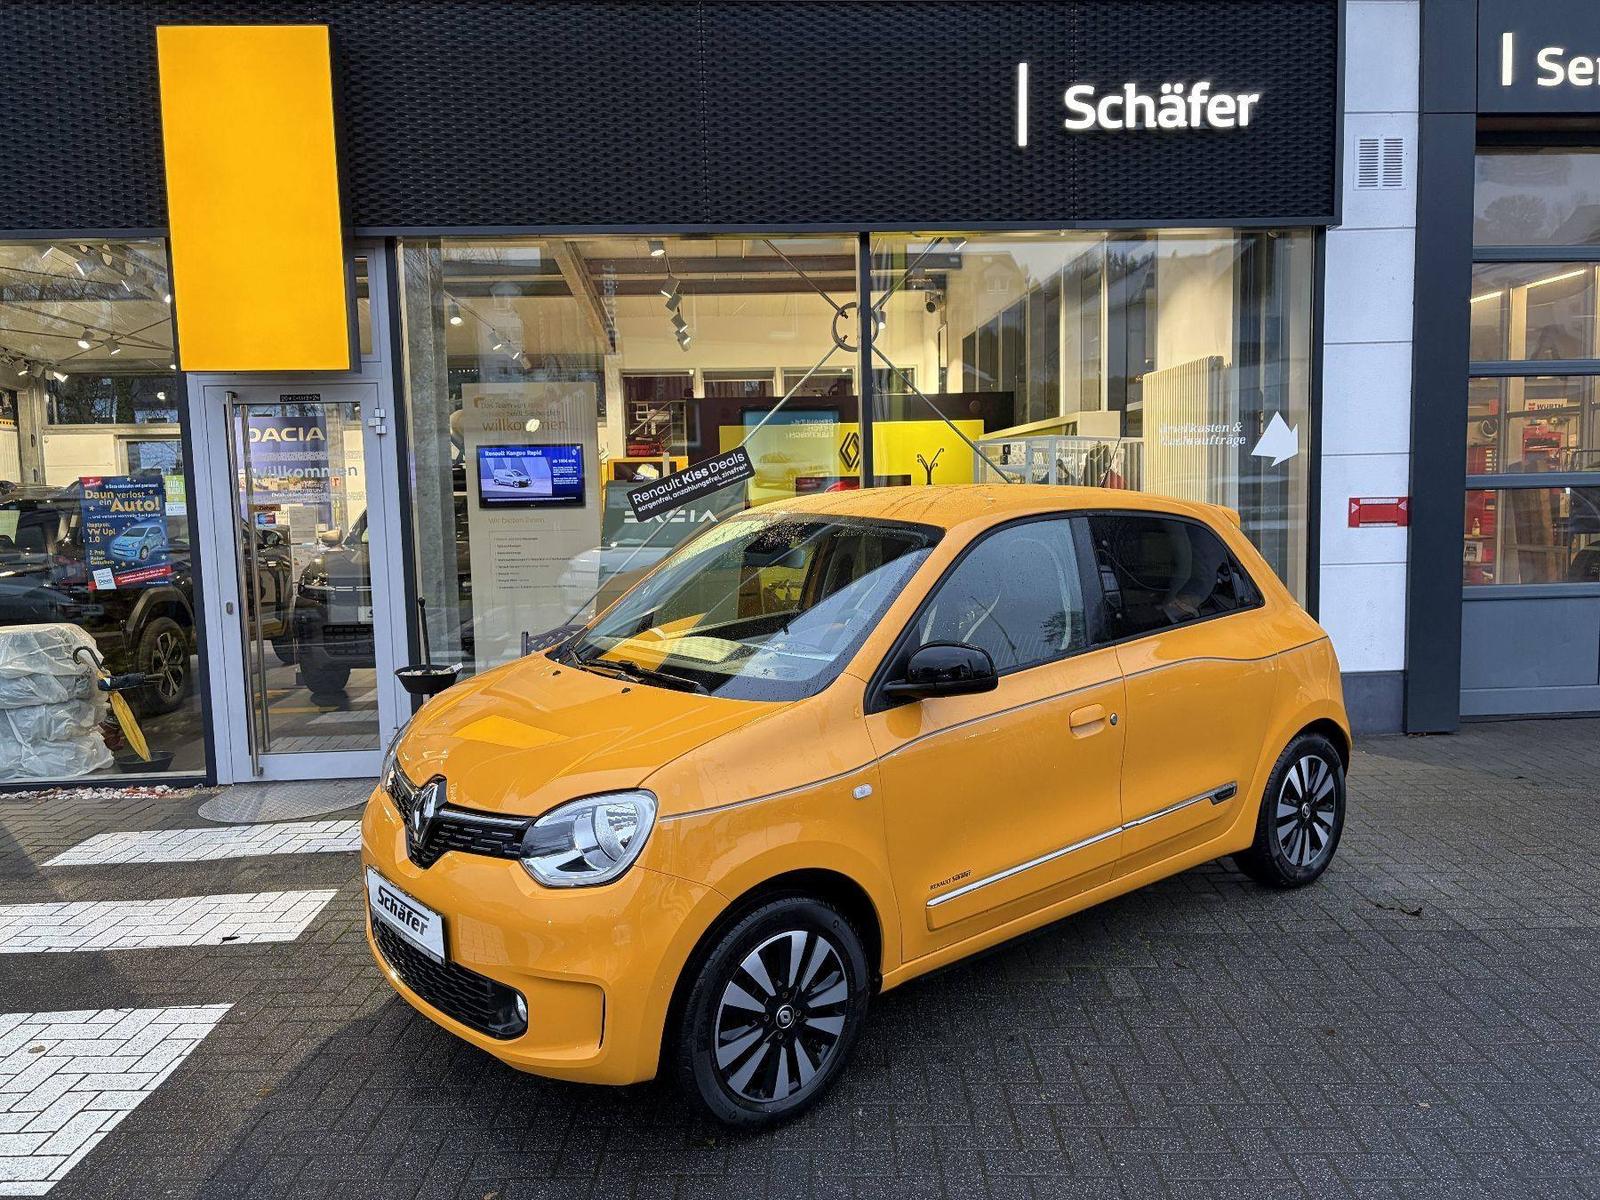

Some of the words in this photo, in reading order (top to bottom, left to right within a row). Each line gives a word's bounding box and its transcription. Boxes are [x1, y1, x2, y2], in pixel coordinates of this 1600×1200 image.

[1064, 82, 1259, 129] Schäfer
[249, 427, 325, 442] DACIA
[1232, 421, 1243, 432] &
[632, 478, 682, 505] Renault
[682, 467, 709, 485] Kiss
[709, 453, 745, 474] Deals
[84, 489, 114, 499] Daun
[116, 491, 146, 499] verlost
[110, 496, 160, 512] Auto!
[637, 495, 673, 512] sorgenfrei,
[672, 475, 722, 498] anzahlungsfrei,
[377, 885, 429, 936] Schäfer
